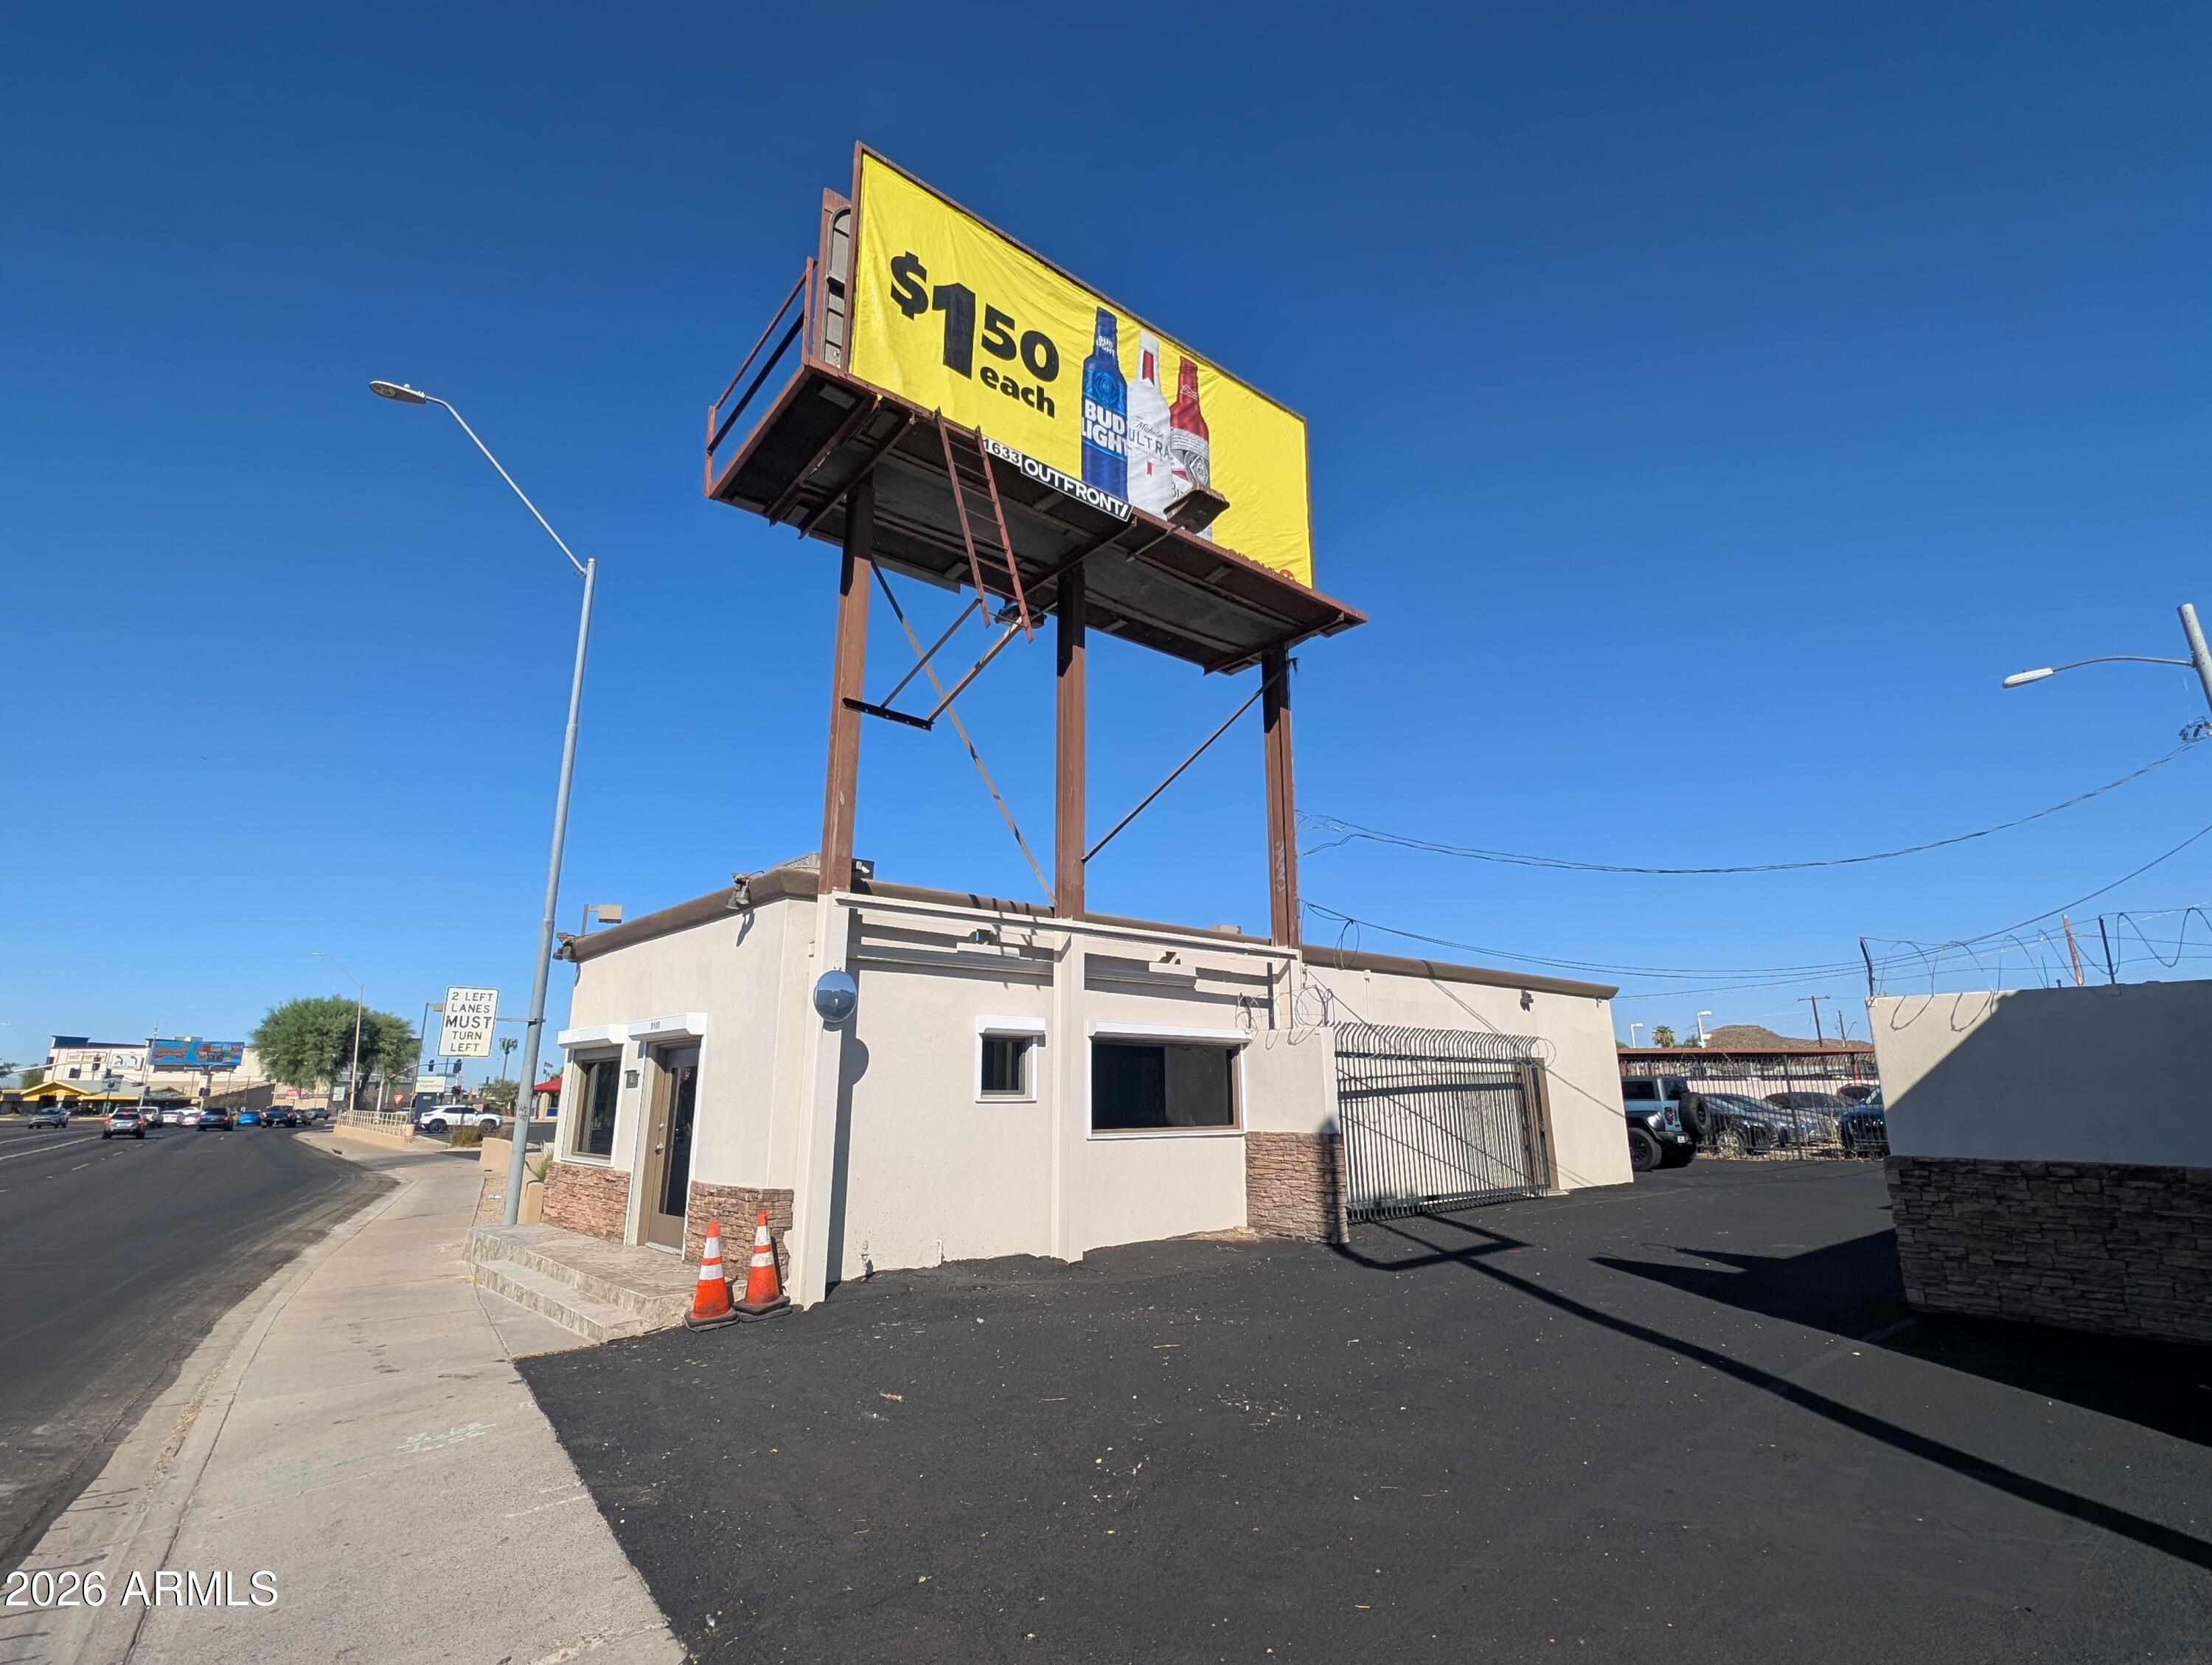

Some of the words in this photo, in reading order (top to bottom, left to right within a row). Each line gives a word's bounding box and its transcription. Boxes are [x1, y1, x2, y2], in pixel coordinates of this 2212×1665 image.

[979, 366, 1055, 419] each
[1085, 399, 1125, 435] BUD
[1129, 428, 1170, 459] ULTRA
[451, 992, 459, 1001] 2
[465, 993, 493, 1001] LEFT
[451, 1004, 490, 1013] LANES
[445, 1015, 492, 1029] MUST
[453, 1031, 482, 1040] TURN
[451, 1043, 479, 1052] LEFT
